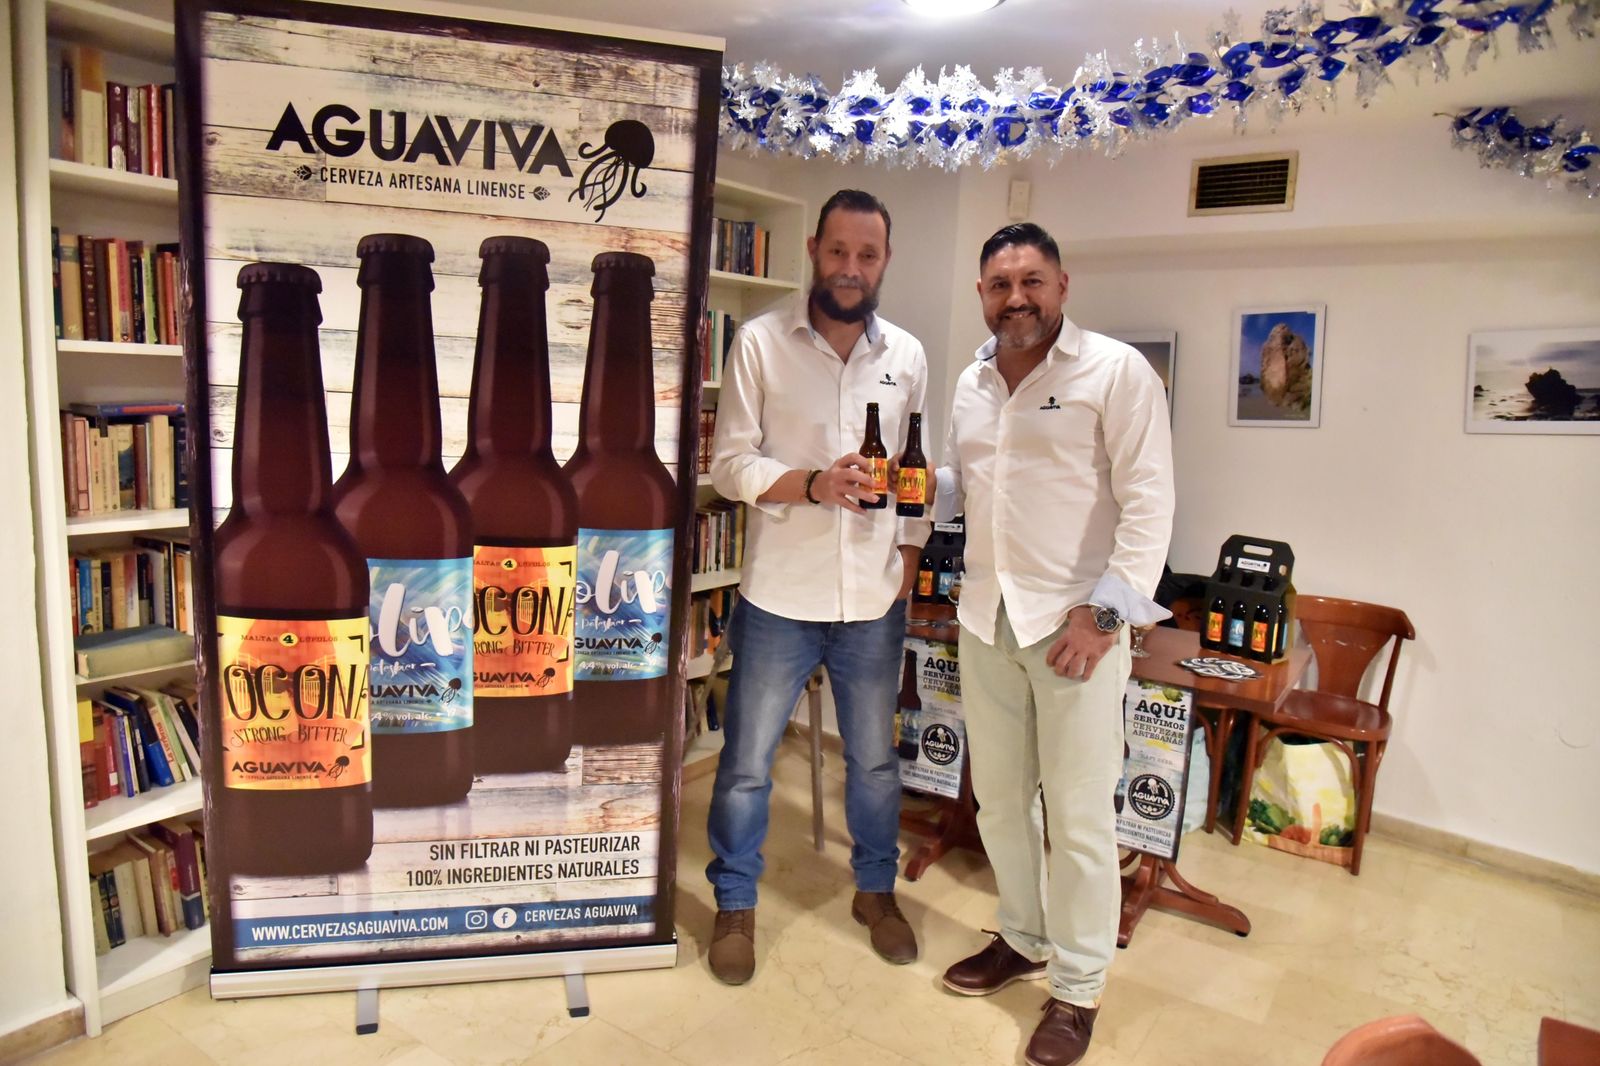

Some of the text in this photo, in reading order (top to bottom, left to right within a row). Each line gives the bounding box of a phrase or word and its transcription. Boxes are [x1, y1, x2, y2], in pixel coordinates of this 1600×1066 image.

[265, 101, 574, 178] AGUAVIVA
[319, 166, 526, 200] CERVEZA ARTESANA LINENSE
[504, 560, 513, 569] 4
[241, 634, 279, 643] MALTAS
[282, 635, 294, 644] 4
[574, 638, 643, 650] GUAVIVA
[504, 640, 560, 659] BITTER
[923, 656, 960, 674] AQU
[923, 670, 961, 682] SERVIMO
[923, 678, 961, 690] CERVEZA
[923, 684, 962, 697] ARTESANA
[1135, 699, 1187, 721] AQUÍ
[1133, 713, 1185, 731] SERVIMOS
[1133, 722, 1185, 739] CERVEZAS
[231, 723, 353, 748] STRONG BITTER
[1132, 730, 1184, 746] ARTESANAS
[231, 761, 328, 774] AGUAVIVA
[1132, 791, 1170, 806] AGUAVIVA
[429, 835, 641, 862] SIN FILTRAR NI PASTEURIZAR
[406, 859, 640, 887] 100% INGREDIENTES NATURALES
[251, 916, 449, 941] WWW.CERVEZASAGUAVIVA.COM
[524, 907, 581, 922] CERVEZAS
[584, 904, 638, 919] AGUAVIVA
